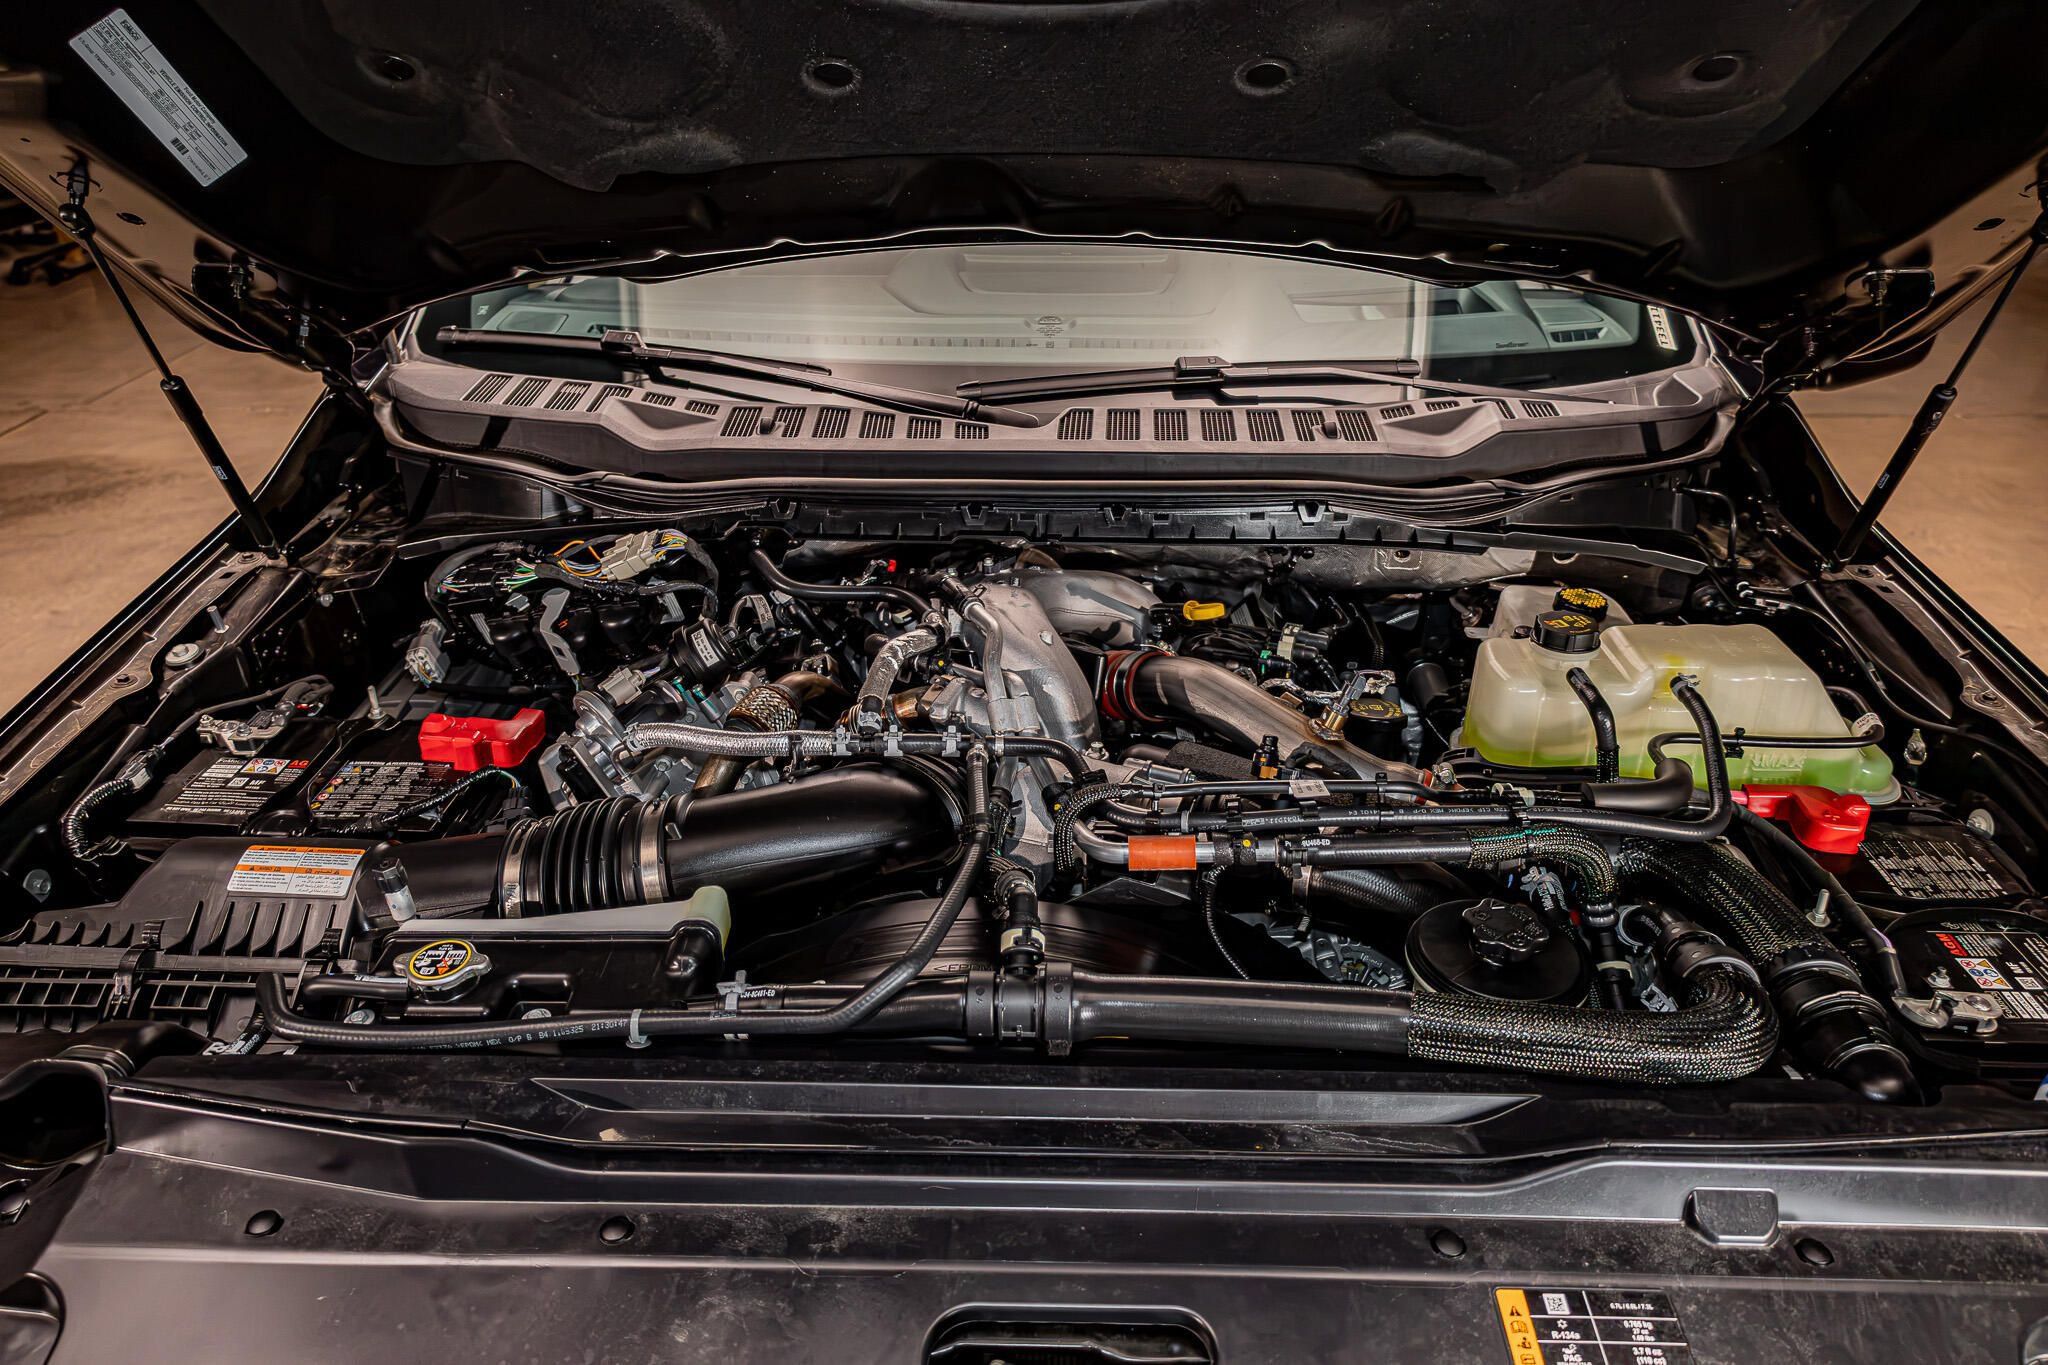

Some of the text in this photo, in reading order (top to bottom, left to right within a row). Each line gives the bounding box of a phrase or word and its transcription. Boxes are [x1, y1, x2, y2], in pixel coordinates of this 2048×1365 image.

[159, 68, 176, 87] VEHICLE
[174, 86, 192, 105] EMISSION
[189, 104, 207, 122] CONTROL
[205, 122, 228, 146] INFORMATION
[183, 86, 216, 124] Ford Motor Company
[1936, 933, 1962, 956] AGM
[1643, 1321, 1653, 1330] kg
[1551, 1331, 1581, 1339] R-134a
[1563, 1354, 1582, 1362] PAG
